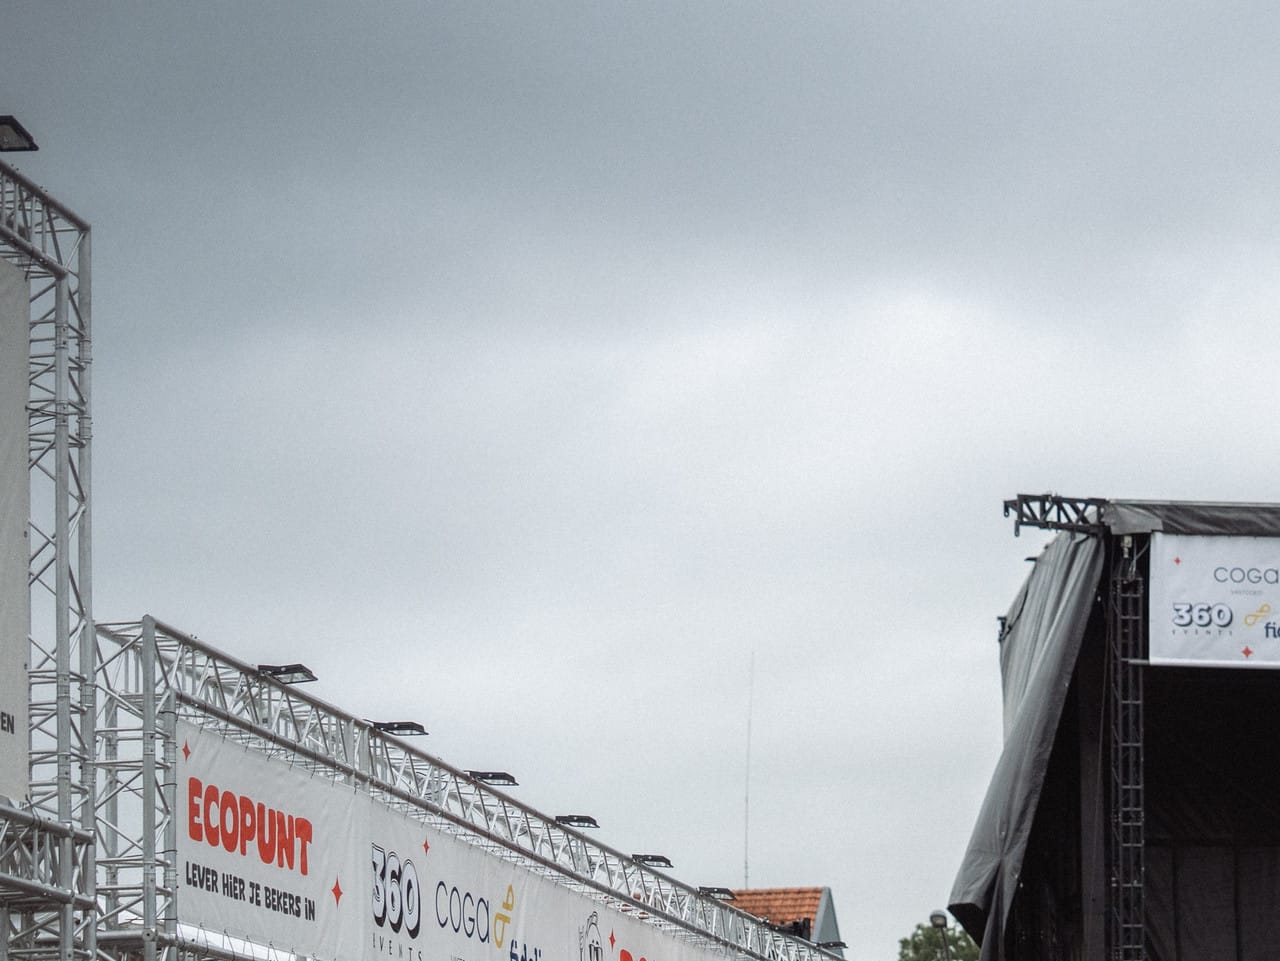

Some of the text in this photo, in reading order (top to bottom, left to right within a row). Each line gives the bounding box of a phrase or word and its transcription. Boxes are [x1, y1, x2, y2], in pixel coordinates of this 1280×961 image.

[1173, 603, 1233, 628] 360
[189, 777, 312, 876] ECOPUNT
[186, 861, 218, 893] LEVER
[249, 881, 260, 906] JE
[264, 886, 300, 918] BEKERS
[372, 843, 420, 939] 360
